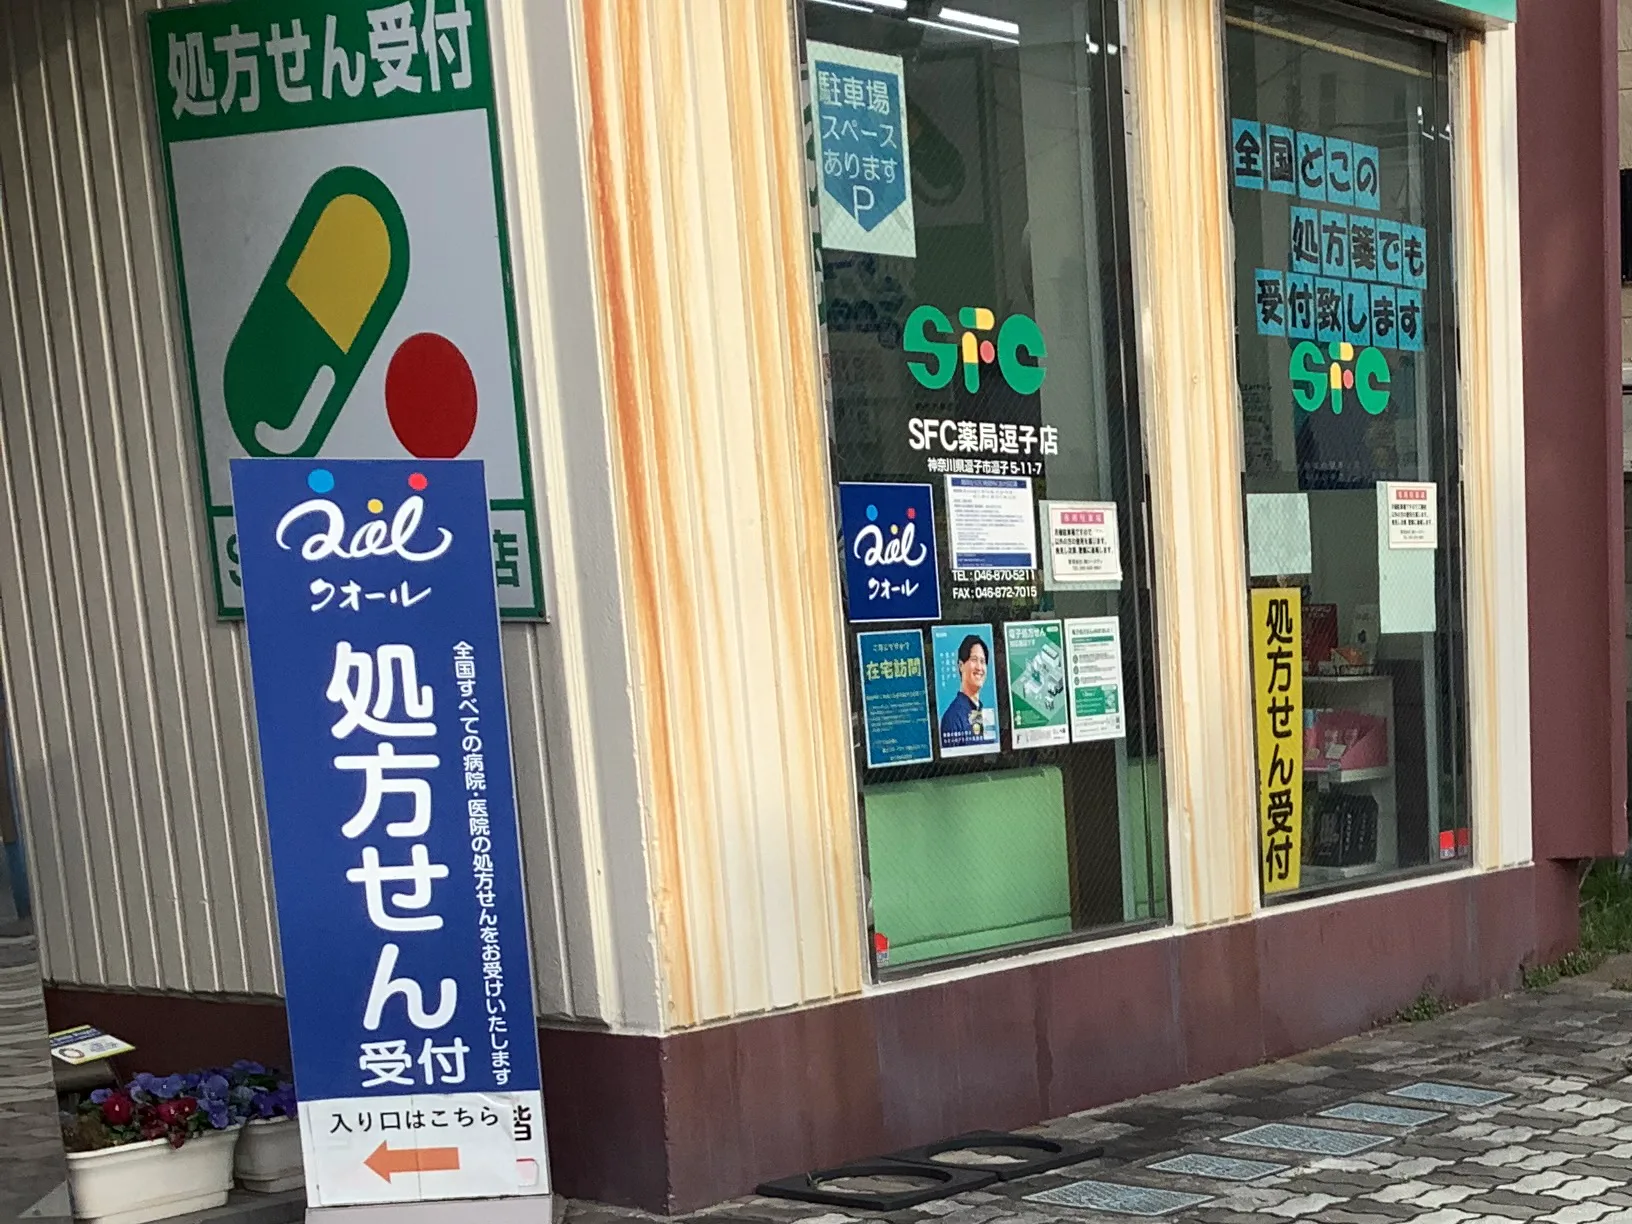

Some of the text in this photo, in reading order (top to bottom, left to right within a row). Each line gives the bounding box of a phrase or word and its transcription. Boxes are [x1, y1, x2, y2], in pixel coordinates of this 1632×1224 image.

[166, 0, 473, 120] 処方せん受付
[818, 70, 890, 115] 駐車場
[822, 115, 897, 149] スペース
[824, 149, 898, 184] あります
[852, 185, 875, 222] P
[1292, 215, 1424, 276] 処方箋でも
[1257, 279, 1420, 340] 受付致します
[903, 305, 1048, 395] SFC
[1289, 341, 1391, 415] SFC
[908, 417, 1059, 455] SFC薬局逗子店
[310, 578, 432, 612] クオール
[868, 577, 919, 600] クオール
[866, 657, 922, 681] 在宅訪問
[1265, 599, 1295, 883] 処方せん受付
[326, 641, 457, 1031] 処方せん
[358, 1037, 469, 1088] 受付
[329, 1105, 500, 1133] 入り口はこちら
